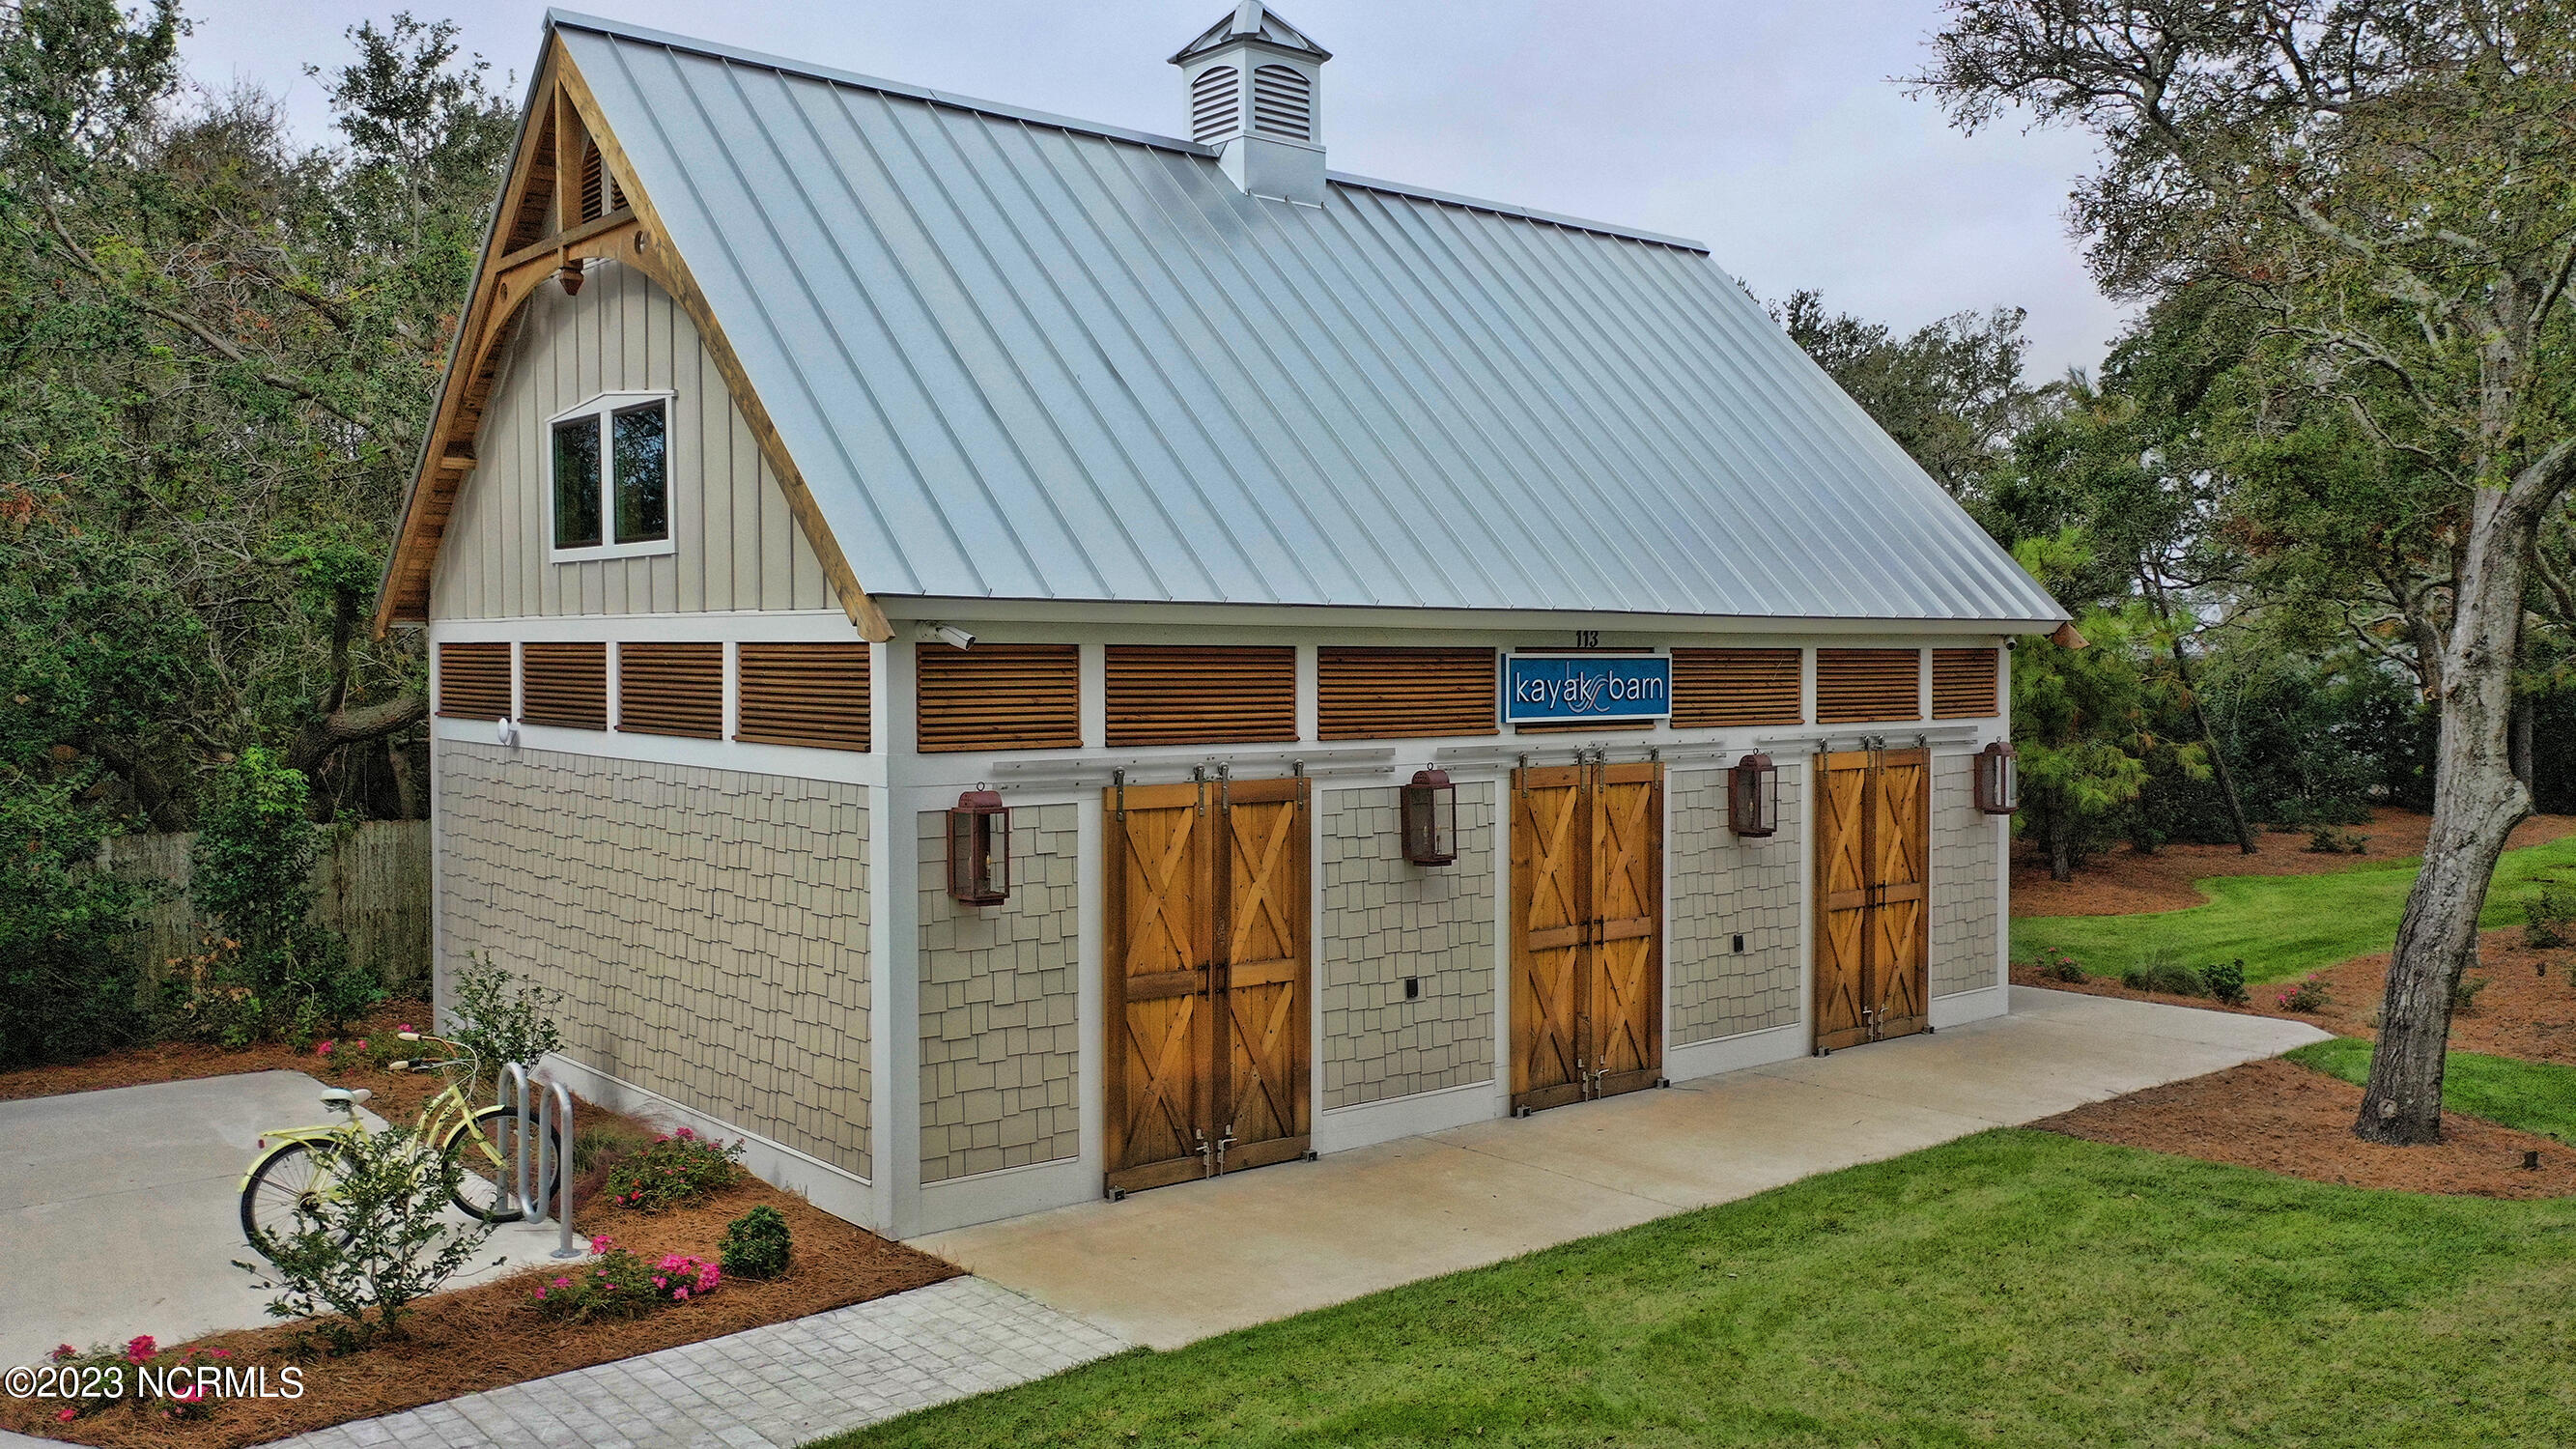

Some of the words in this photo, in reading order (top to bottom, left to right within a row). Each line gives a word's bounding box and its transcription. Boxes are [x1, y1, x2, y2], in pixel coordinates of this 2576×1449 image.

[1575, 630, 1599, 648] 113
[1515, 671, 1594, 709] kayak
[1609, 669, 1663, 700] barn
